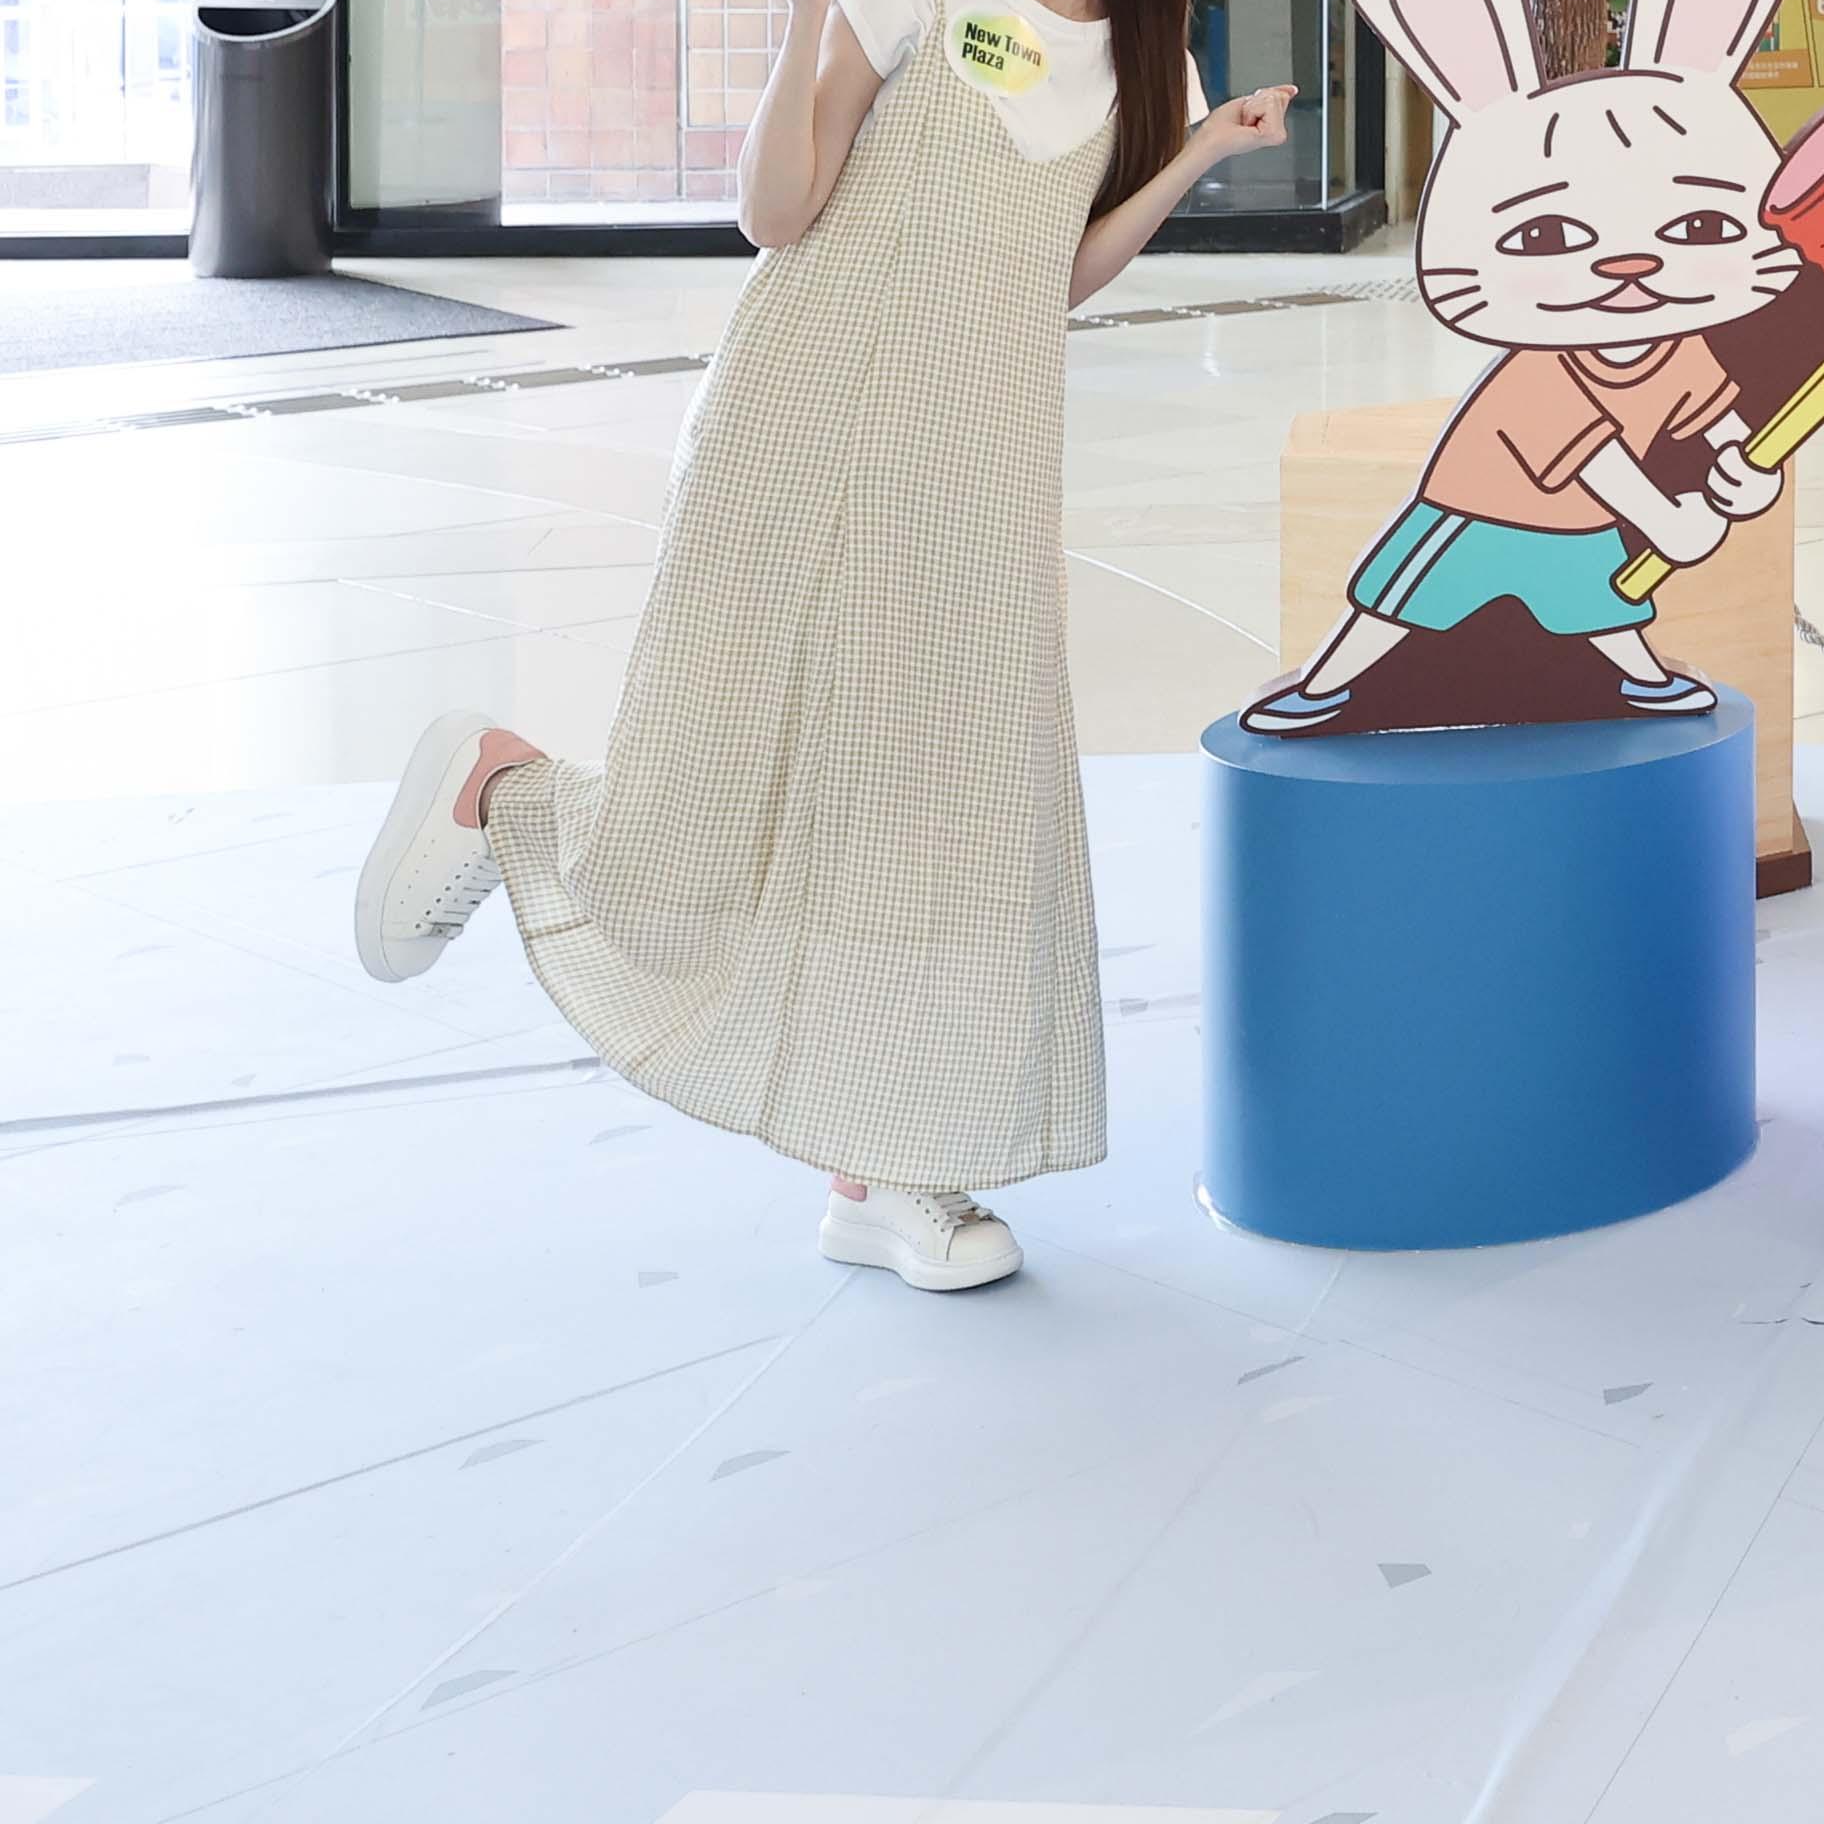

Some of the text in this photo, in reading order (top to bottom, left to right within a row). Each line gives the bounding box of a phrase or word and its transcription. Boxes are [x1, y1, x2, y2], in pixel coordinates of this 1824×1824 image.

[961, 42, 1004, 71] Plaza
[965, 22, 1042, 67] New Town
